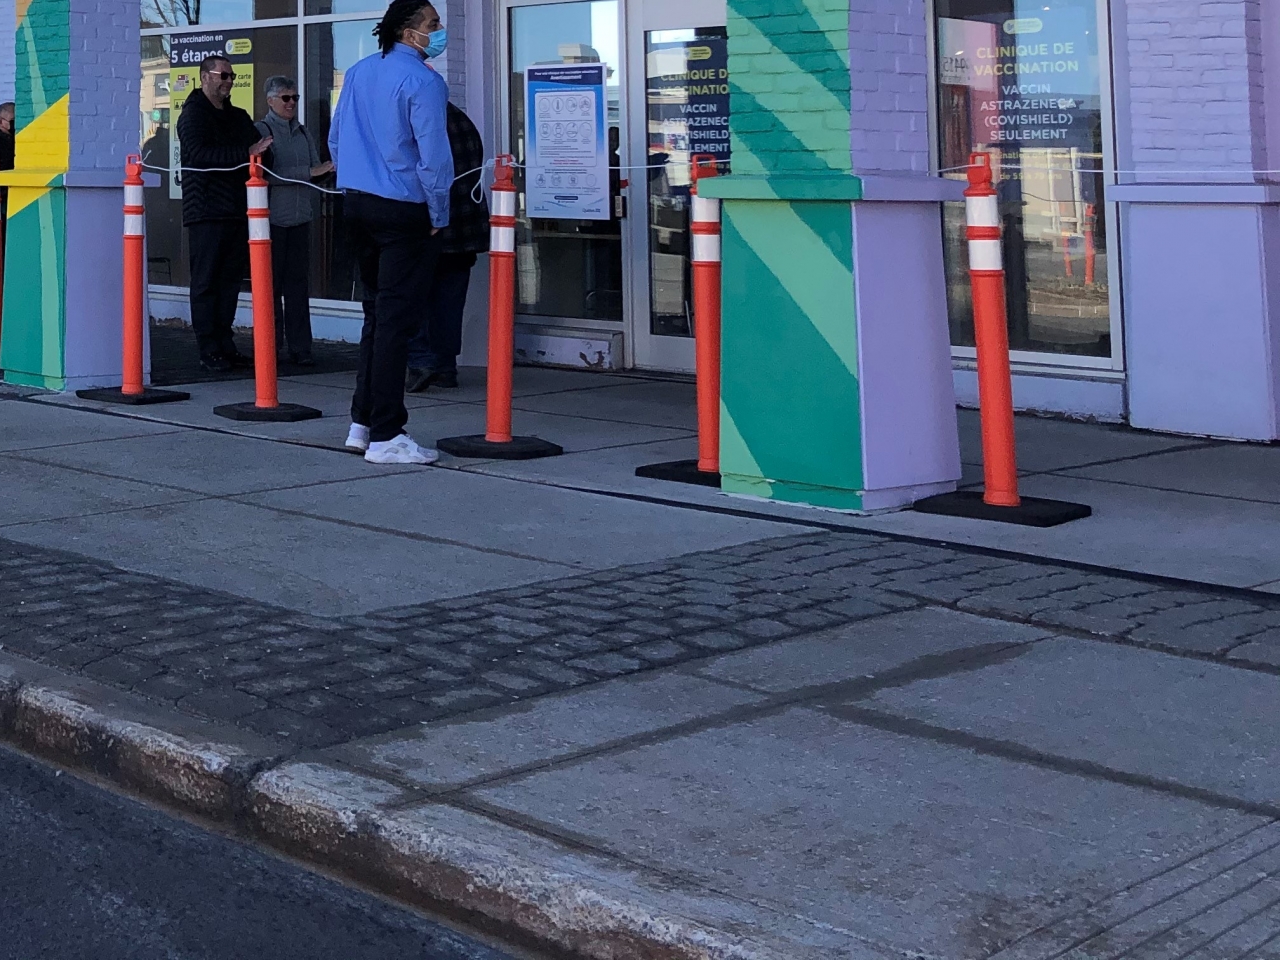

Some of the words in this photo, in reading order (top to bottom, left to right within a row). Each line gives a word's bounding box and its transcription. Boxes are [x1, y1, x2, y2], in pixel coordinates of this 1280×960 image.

[170, 37, 179, 45] La
[179, 34, 214, 44] vaccination
[171, 50, 179, 64] 5
[976, 43, 1048, 59] CLINIQUE
[1053, 42, 1075, 55] DE
[718, 68, 728, 79] D
[973, 60, 1079, 76] VACCINATION
[1001, 83, 1051, 95] VACCIN
[679, 103, 717, 114] VACCIN
[980, 97, 1077, 111] ASTRAZENECA
[662, 116, 729, 127] ASTRAZENEC
[984, 113, 1074, 128] (COVISHIELD)
[990, 128, 1068, 141] SEULEMENT
